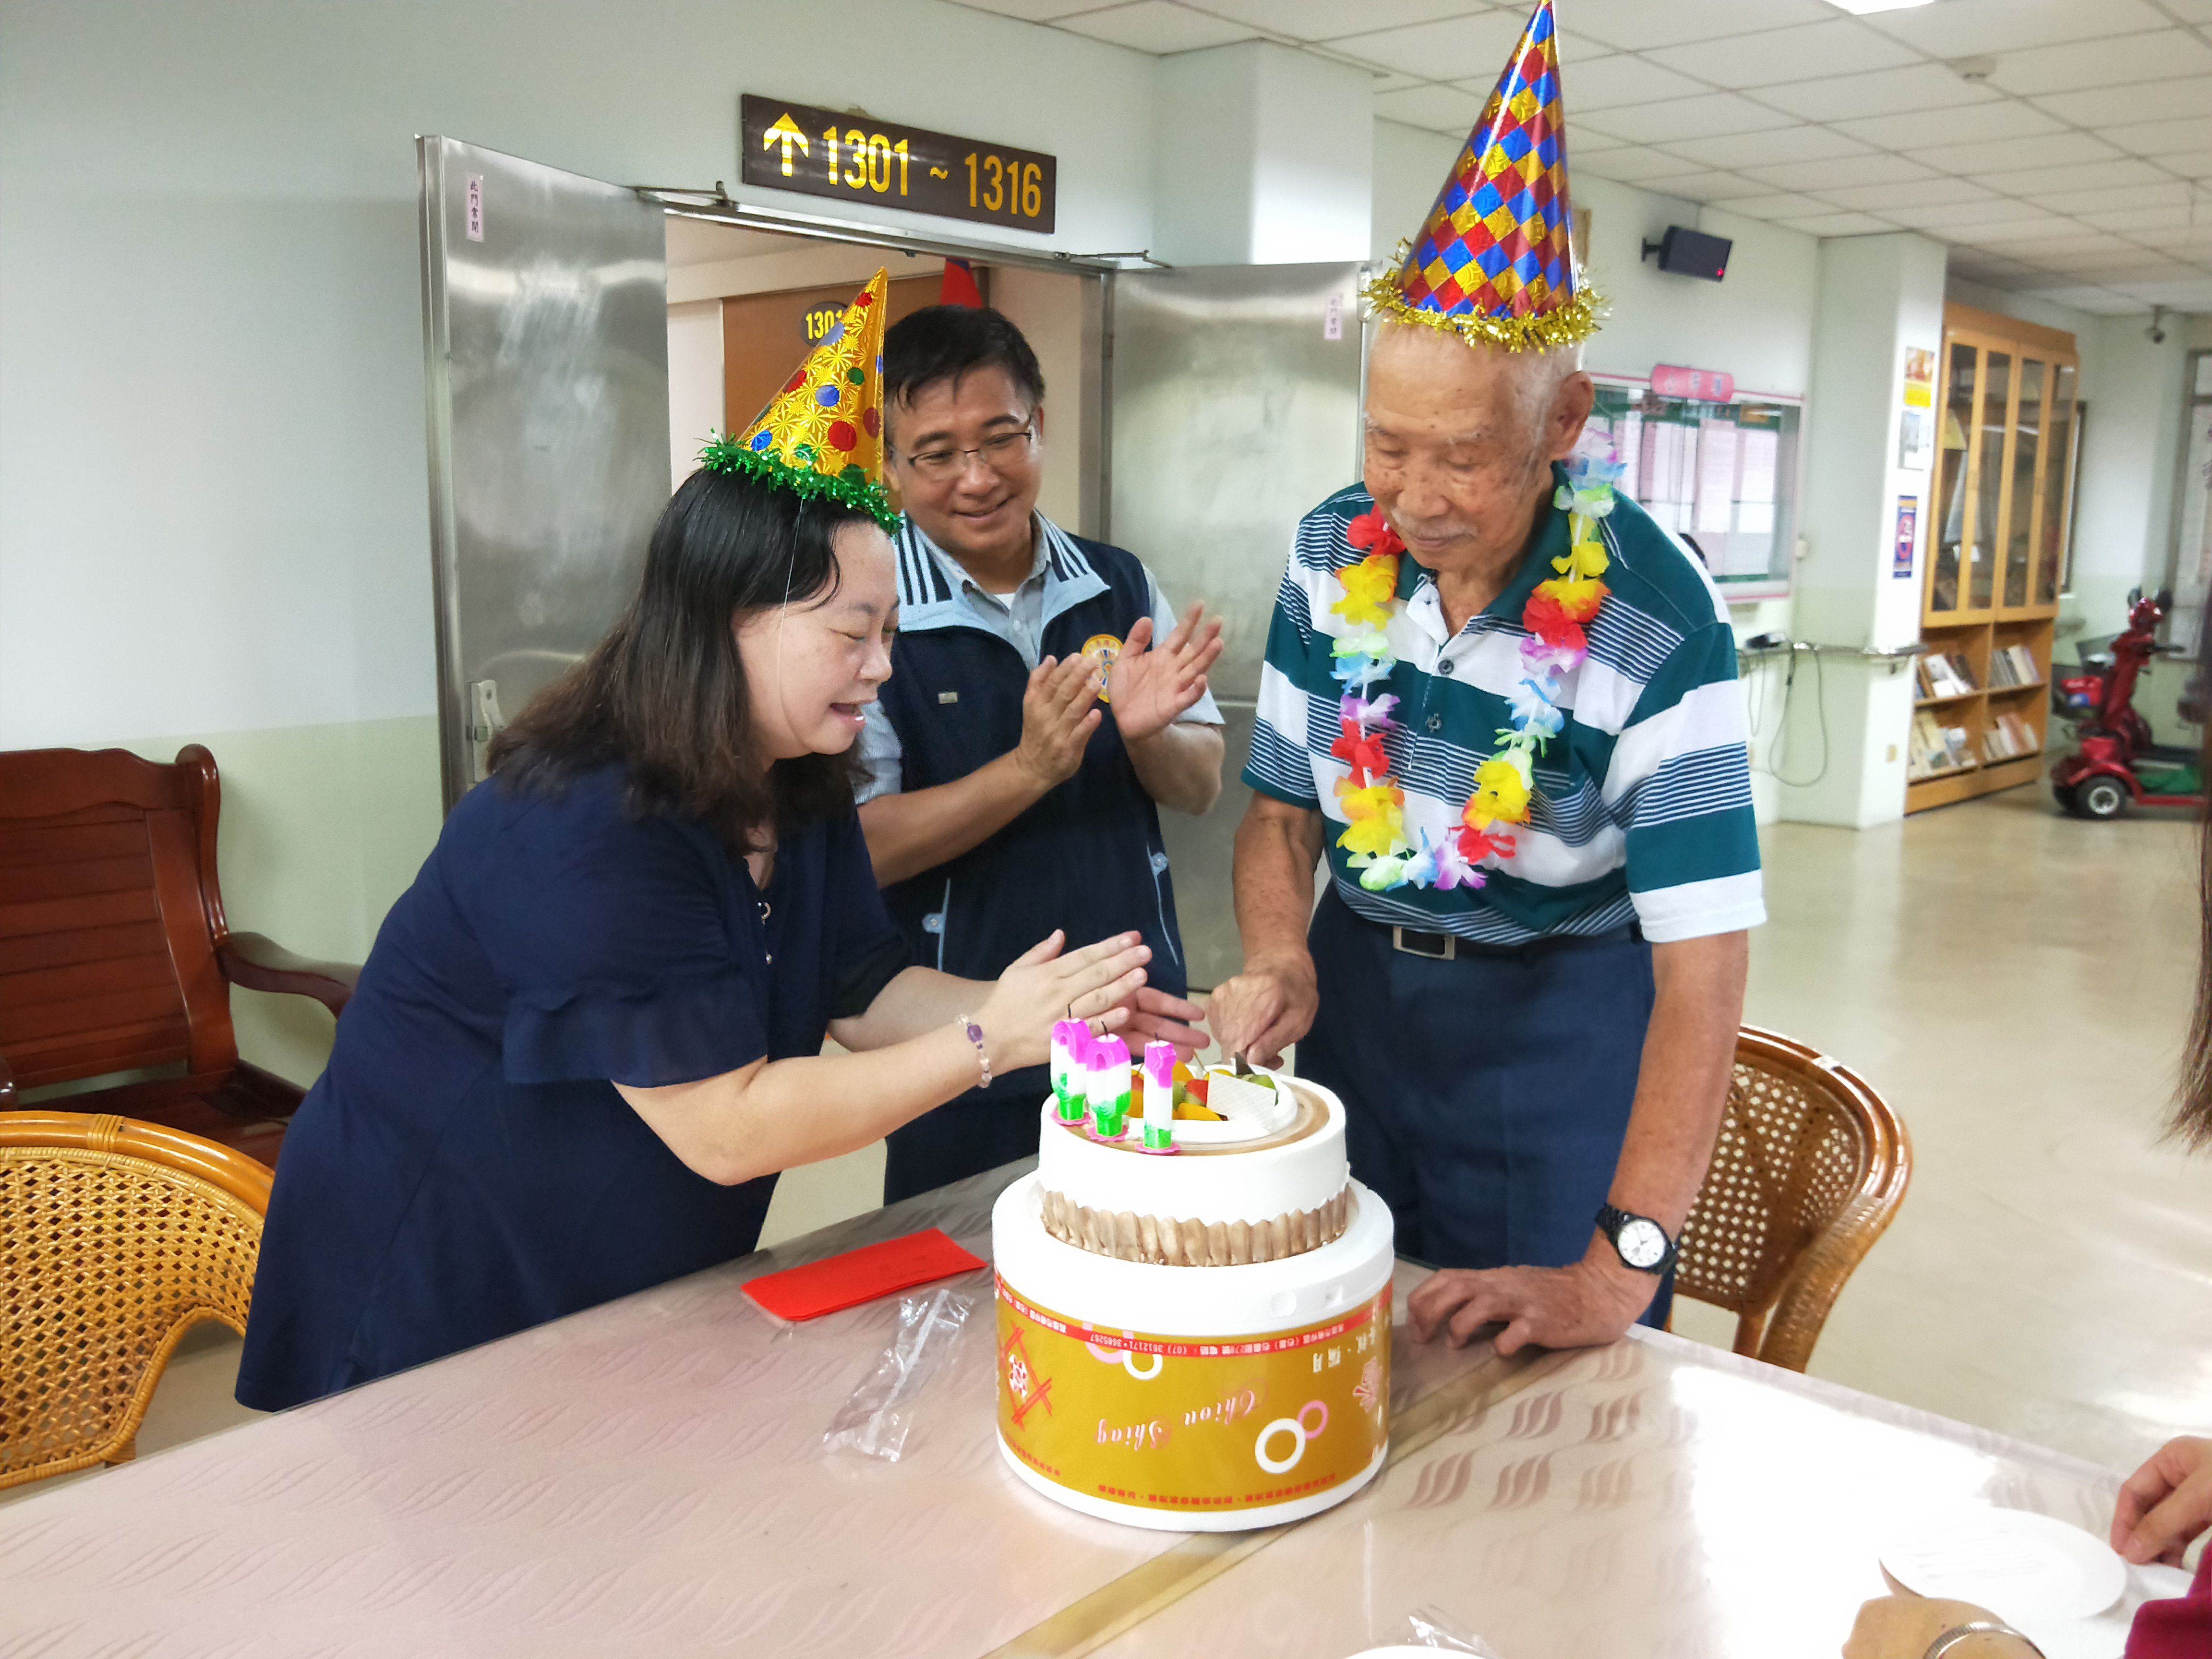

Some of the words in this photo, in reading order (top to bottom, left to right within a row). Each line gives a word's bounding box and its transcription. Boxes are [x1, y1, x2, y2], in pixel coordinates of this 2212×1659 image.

[822, 125, 909, 196] 1301
[964, 153, 1043, 218] 1316
[805, 309, 842, 340] 130
